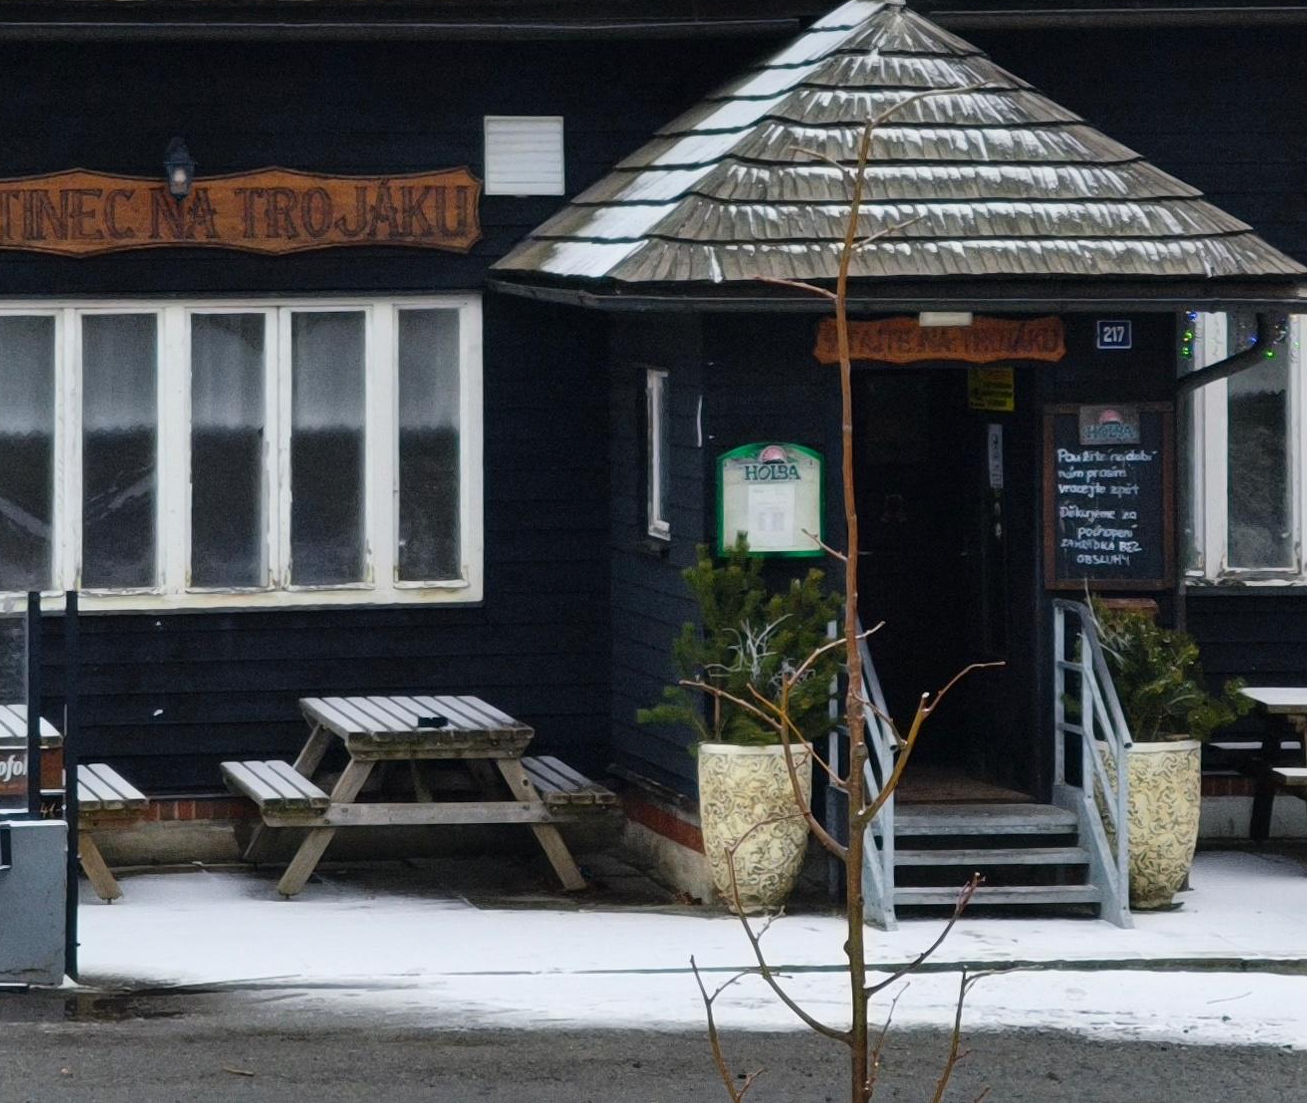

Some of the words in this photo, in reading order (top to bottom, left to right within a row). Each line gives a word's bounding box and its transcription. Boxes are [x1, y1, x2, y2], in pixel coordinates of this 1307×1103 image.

[148, 186, 221, 242] NA
[234, 180, 470, 243] TROJÁKU
[1102, 326, 1126, 343] 217
[744, 464, 802, 481] HOLBA
[1077, 554, 1132, 567] OBSLUHY
